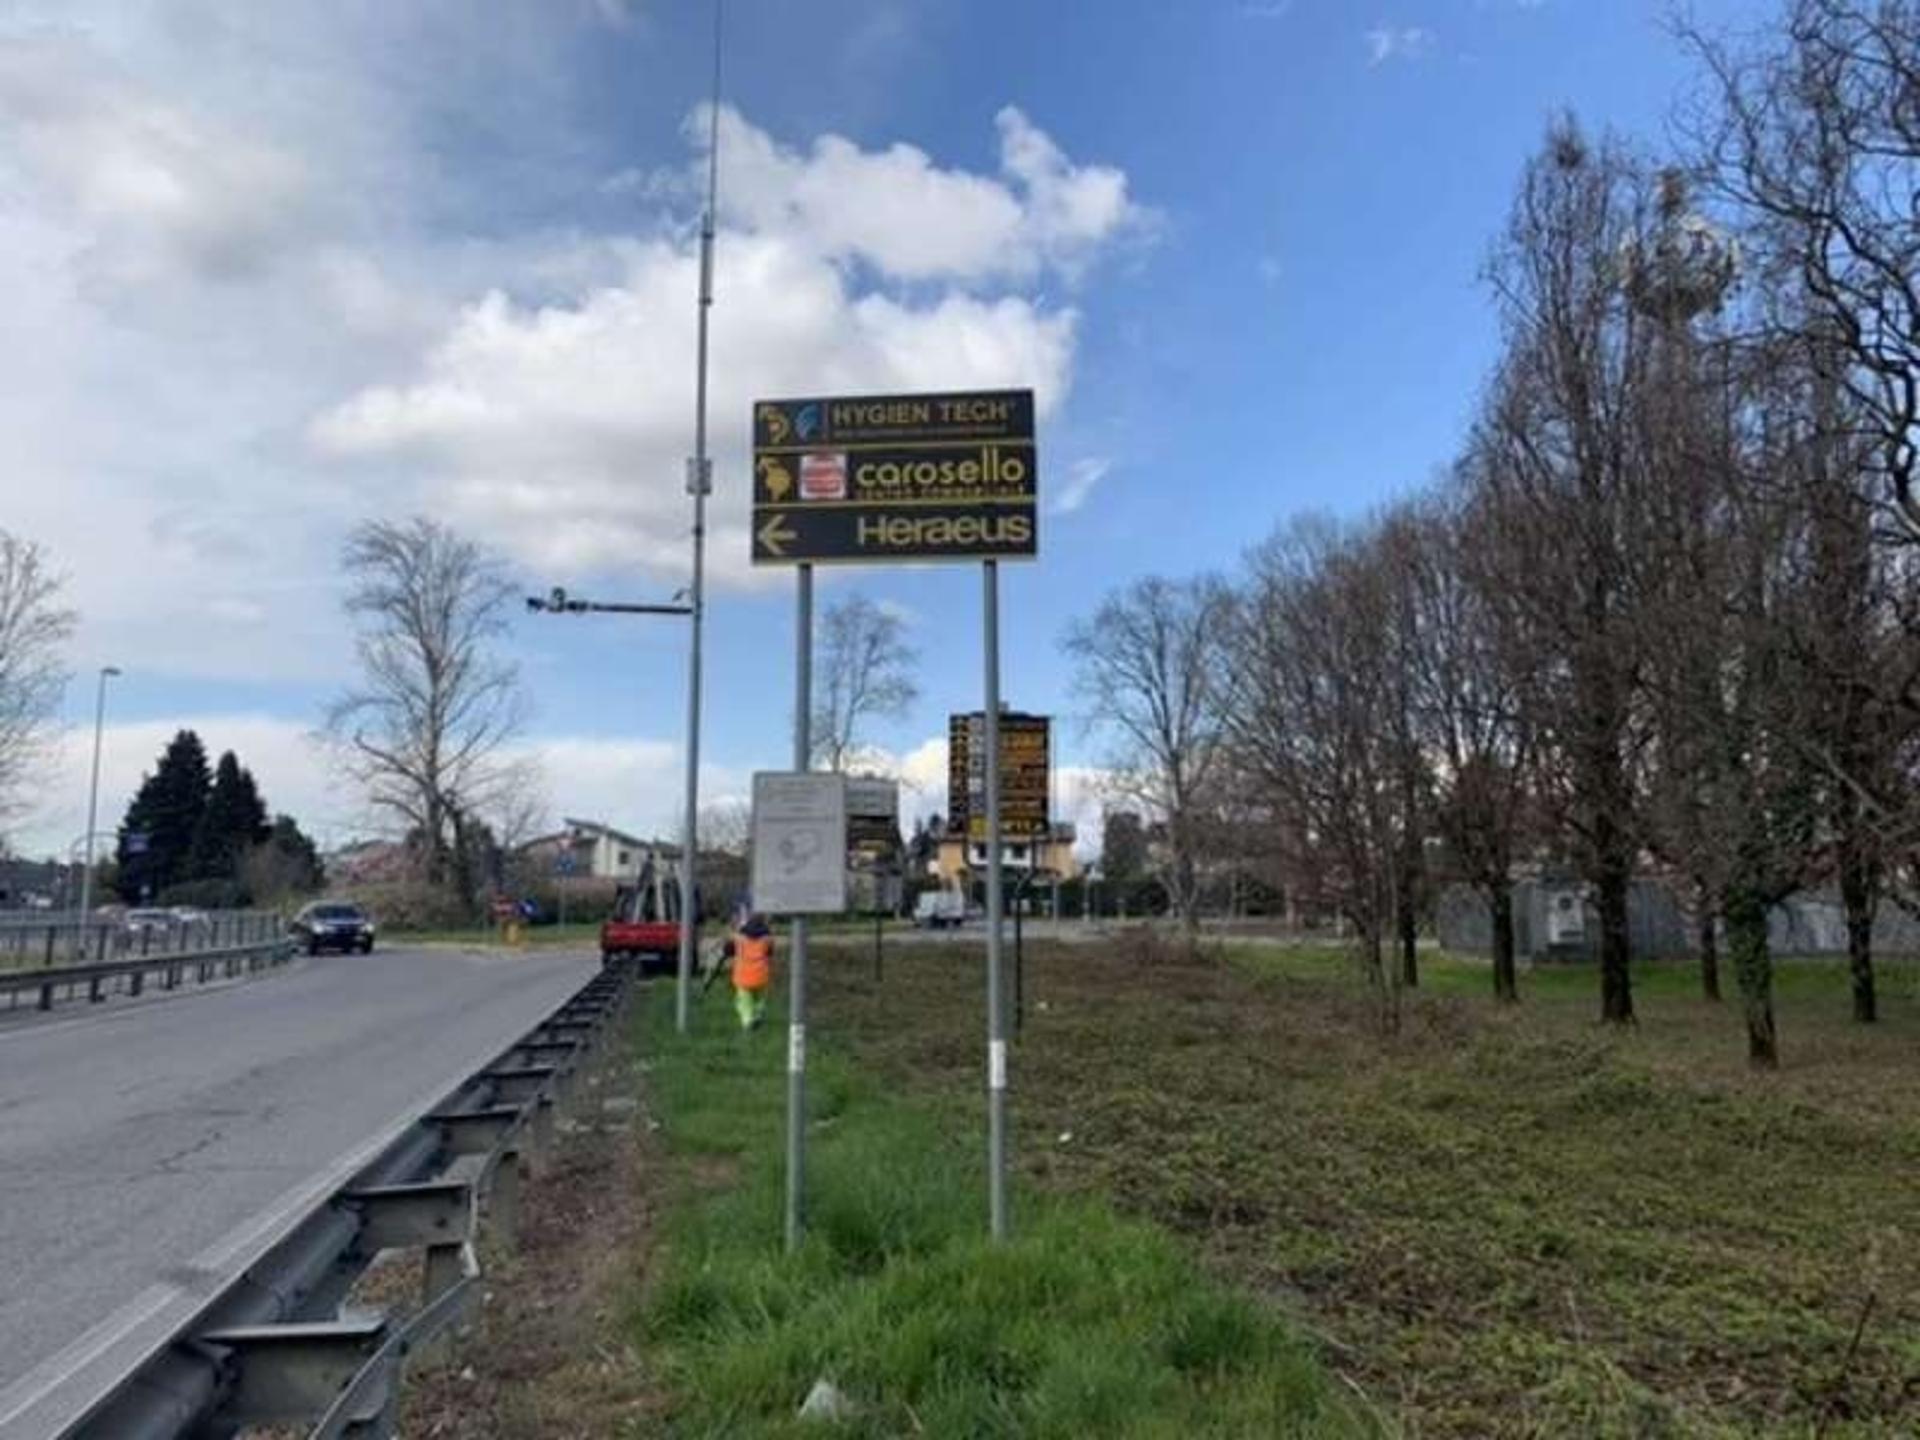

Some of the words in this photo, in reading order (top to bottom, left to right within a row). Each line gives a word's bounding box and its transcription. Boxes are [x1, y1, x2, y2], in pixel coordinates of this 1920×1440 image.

[833, 403, 929, 426] HYGIEN
[856, 445, 1025, 487] carosello
[857, 515, 1031, 546] Heraeus
